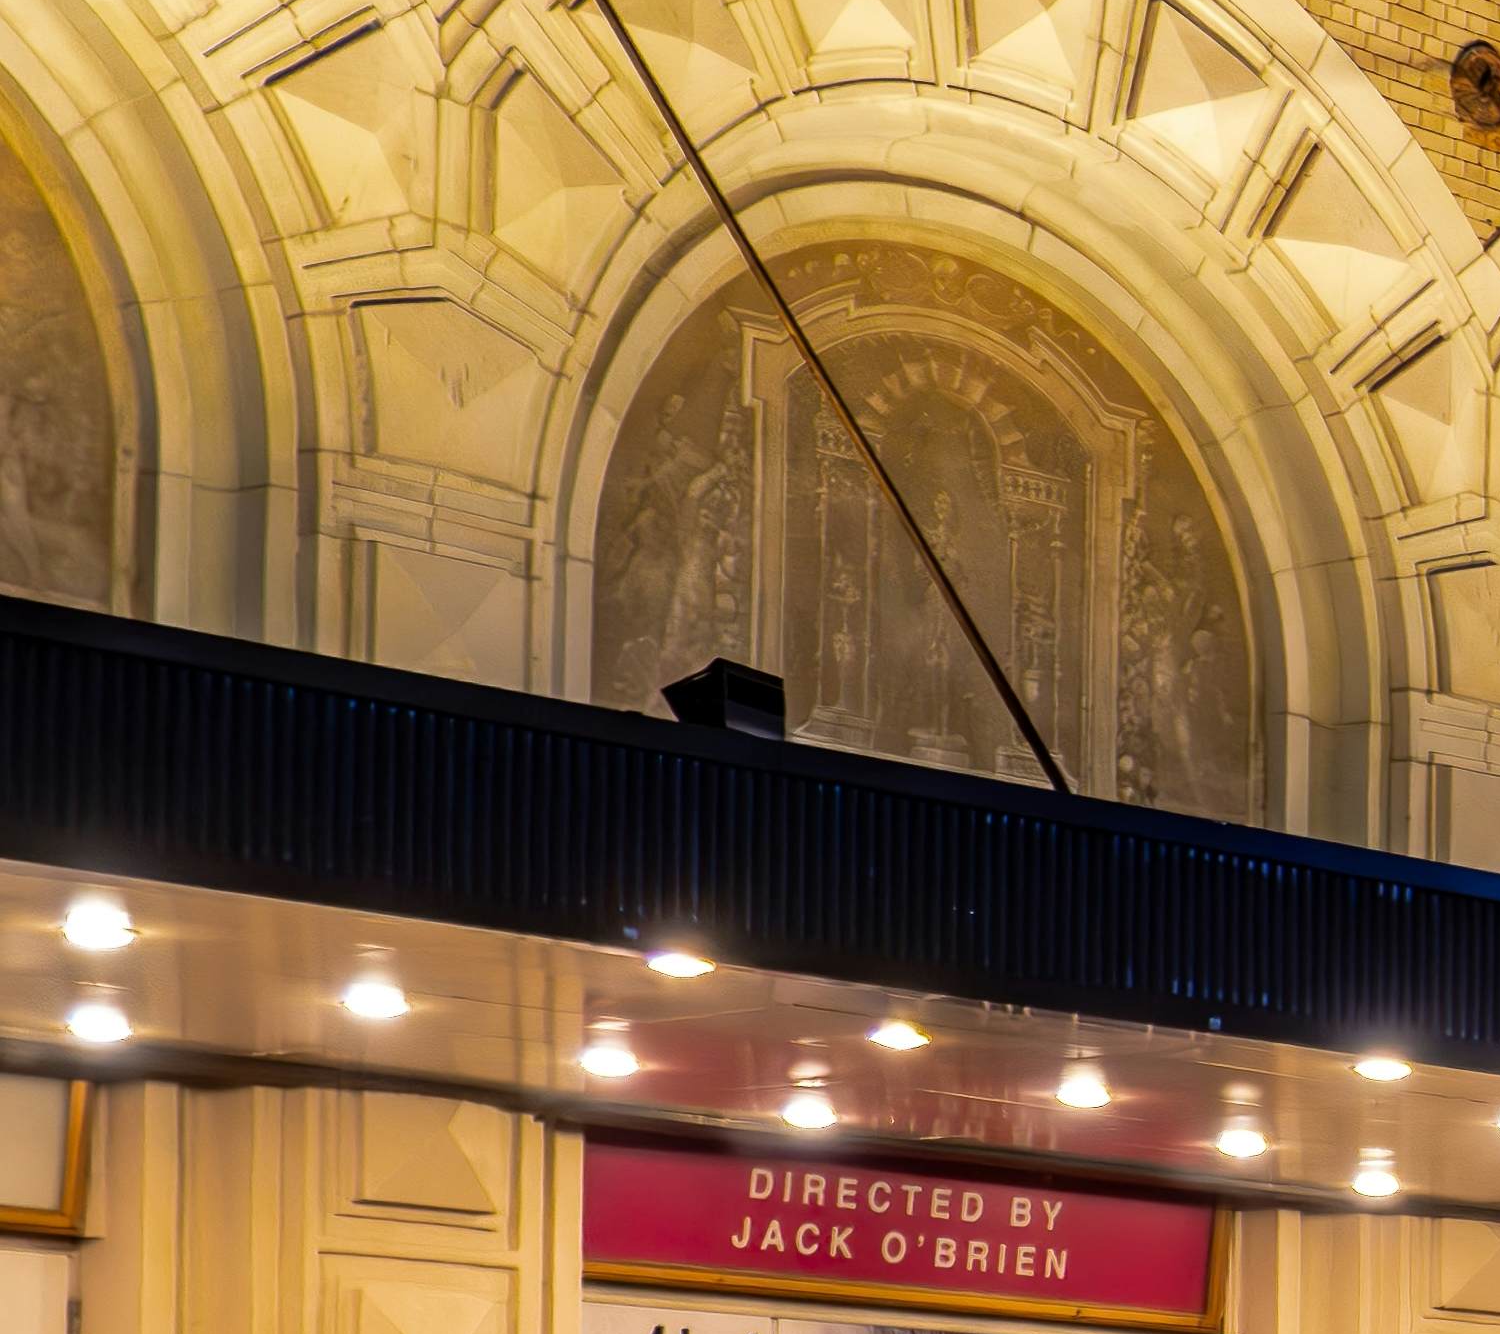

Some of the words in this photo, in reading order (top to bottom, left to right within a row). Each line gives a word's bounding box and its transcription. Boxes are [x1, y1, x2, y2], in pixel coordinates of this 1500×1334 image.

[747, 1167, 986, 1223] DIRECTED
[1009, 1194, 1065, 1232] BY
[730, 1215, 854, 1261] JACK
[881, 1229, 1069, 1281] O'BRIEN
